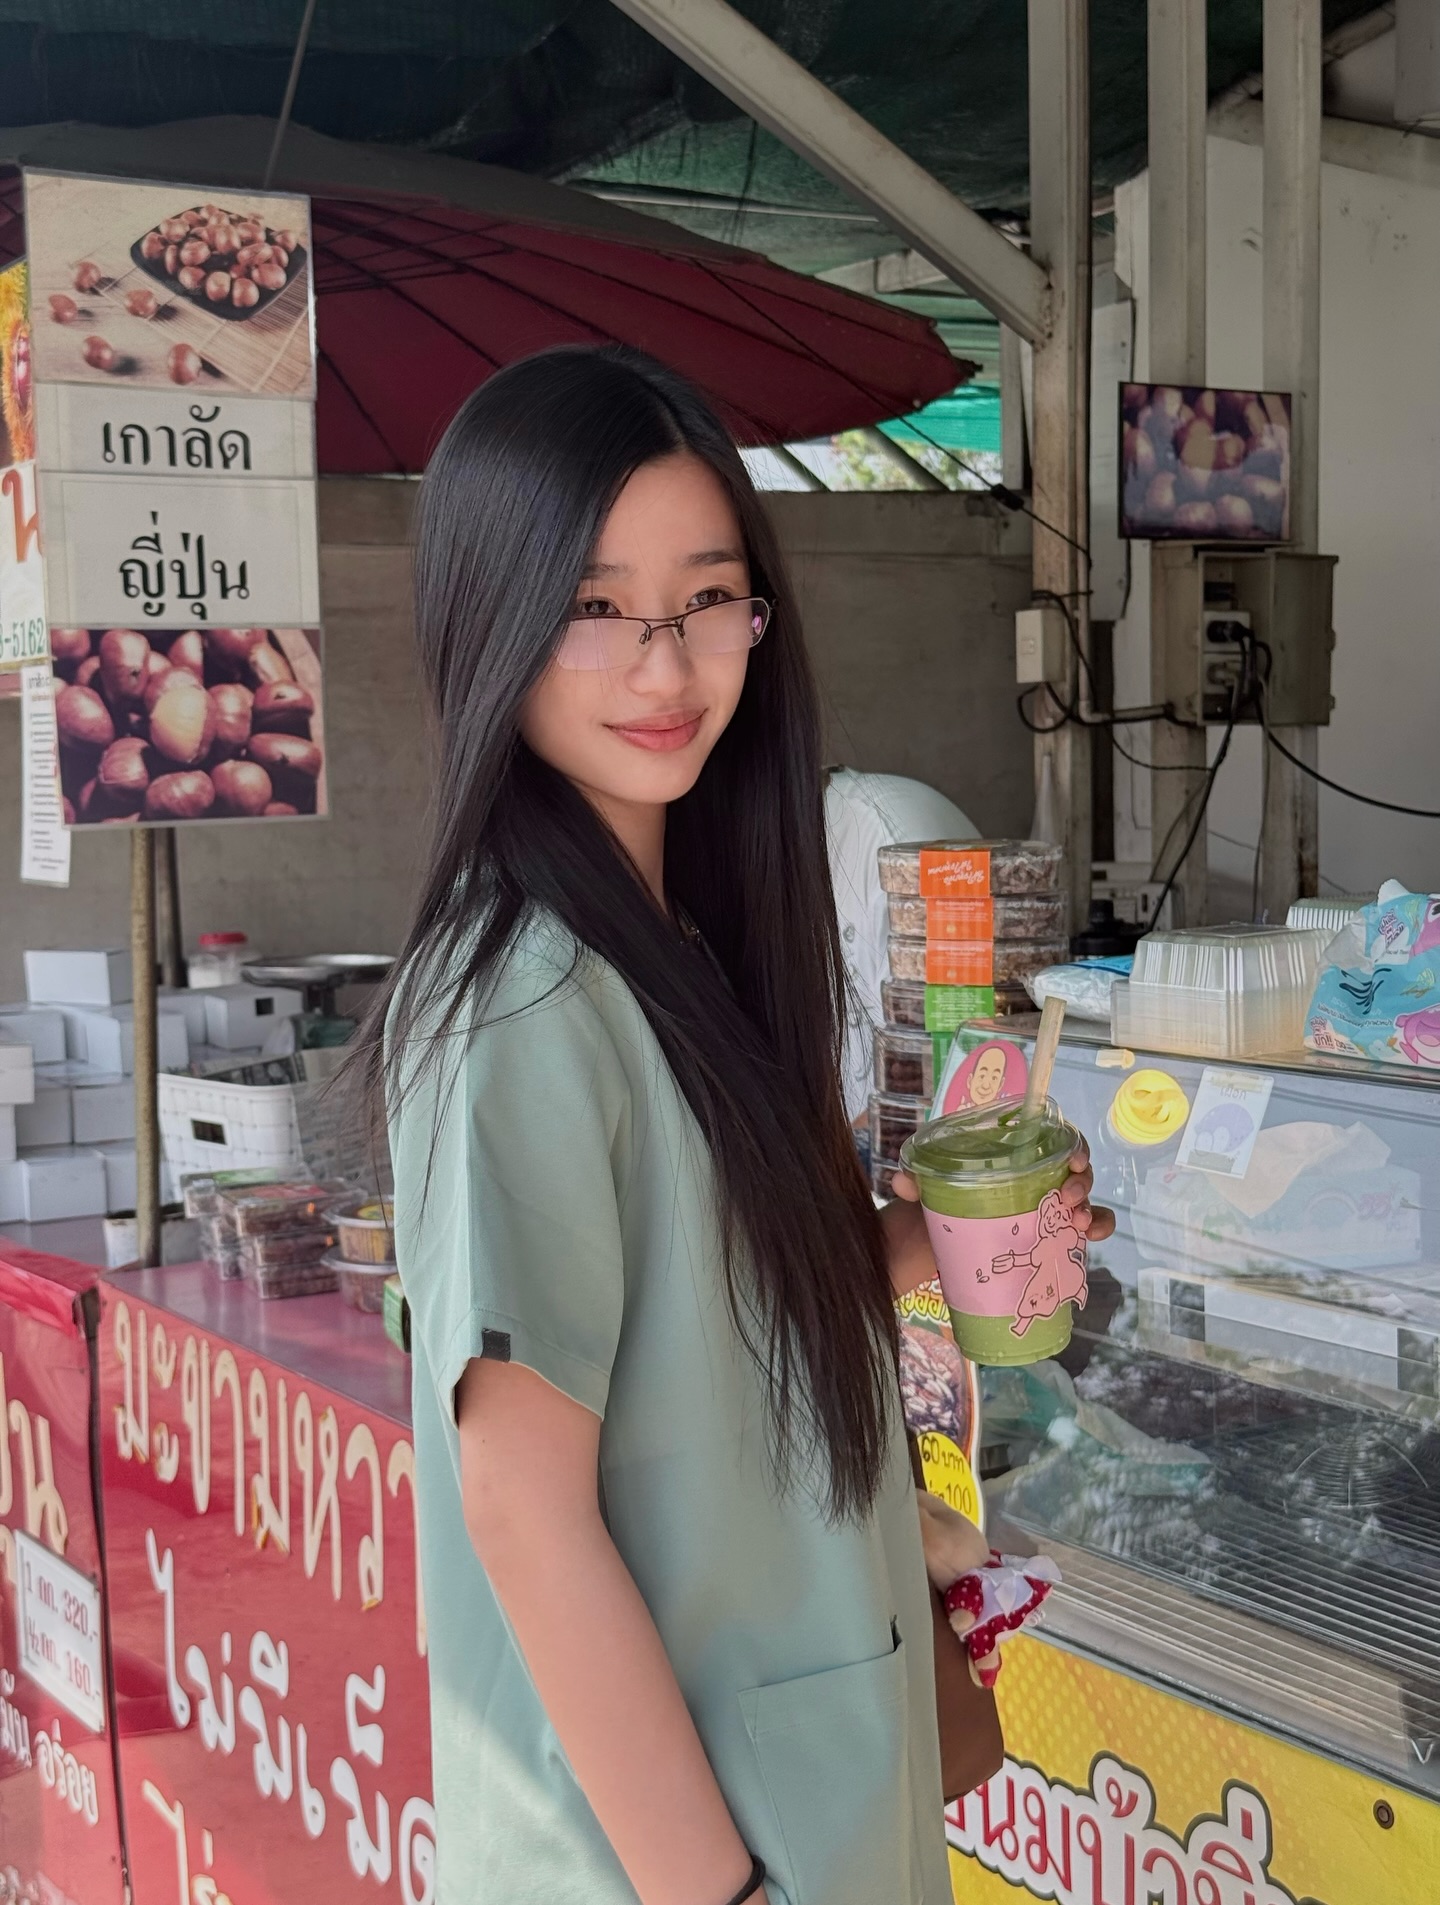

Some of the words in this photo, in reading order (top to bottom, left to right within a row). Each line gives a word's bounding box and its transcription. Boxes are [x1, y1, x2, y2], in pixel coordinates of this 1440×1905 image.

[102, 403, 252, 473] เกาลัด
[119, 511, 250, 621] ญี่ปุ่น
[0, 618, 45, 657] -5162
[24, 1561, 33, 1593] 1
[34, 1718, 99, 1826] อร่อย
